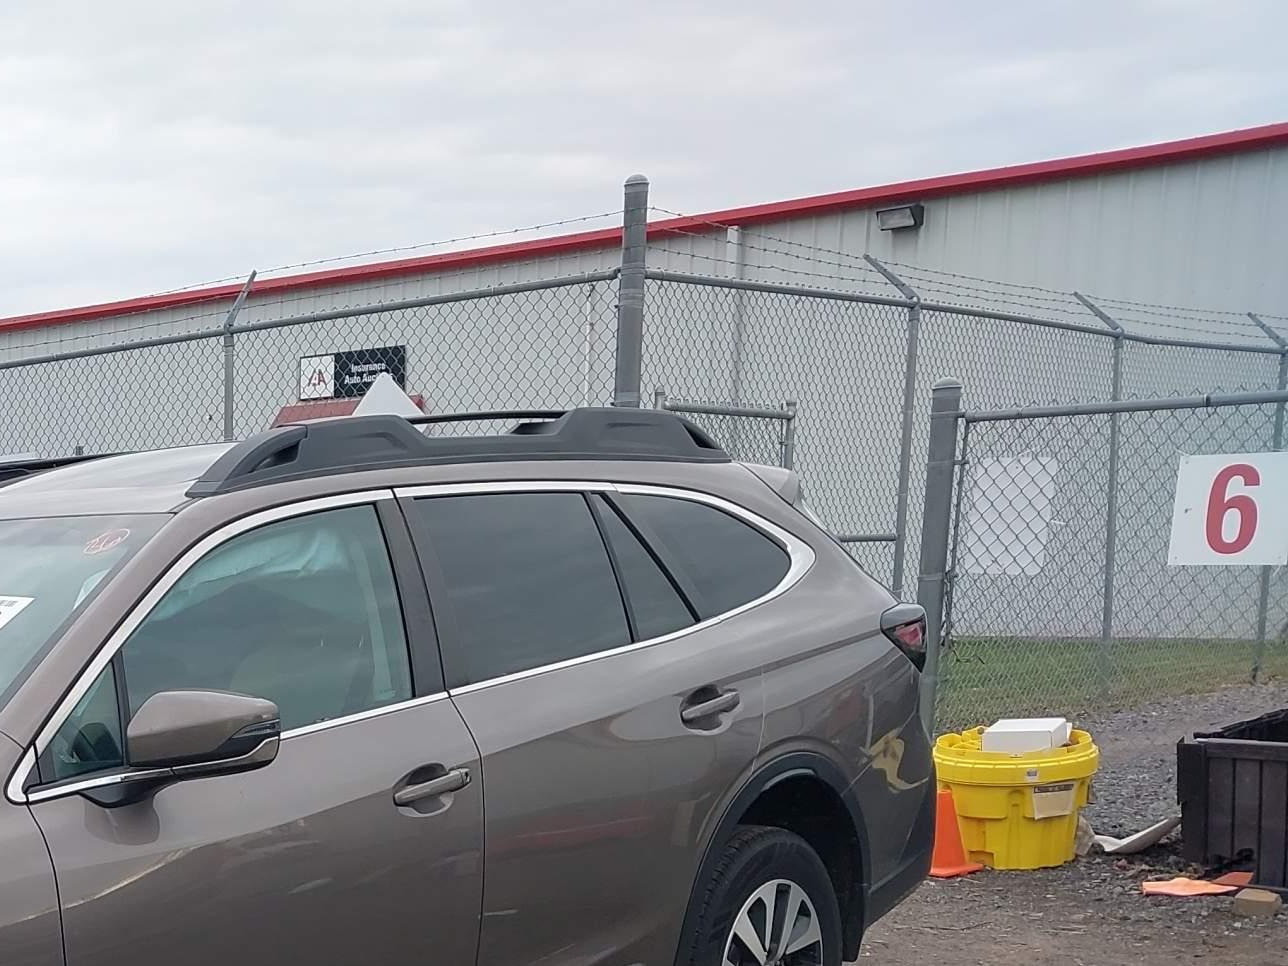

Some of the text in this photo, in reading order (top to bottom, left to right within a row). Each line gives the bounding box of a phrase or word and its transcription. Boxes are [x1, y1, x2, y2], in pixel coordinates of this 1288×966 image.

[351, 363, 386, 372] Insurance
[344, 375, 361, 384] Auto
[1206, 463, 1260, 554] 6
